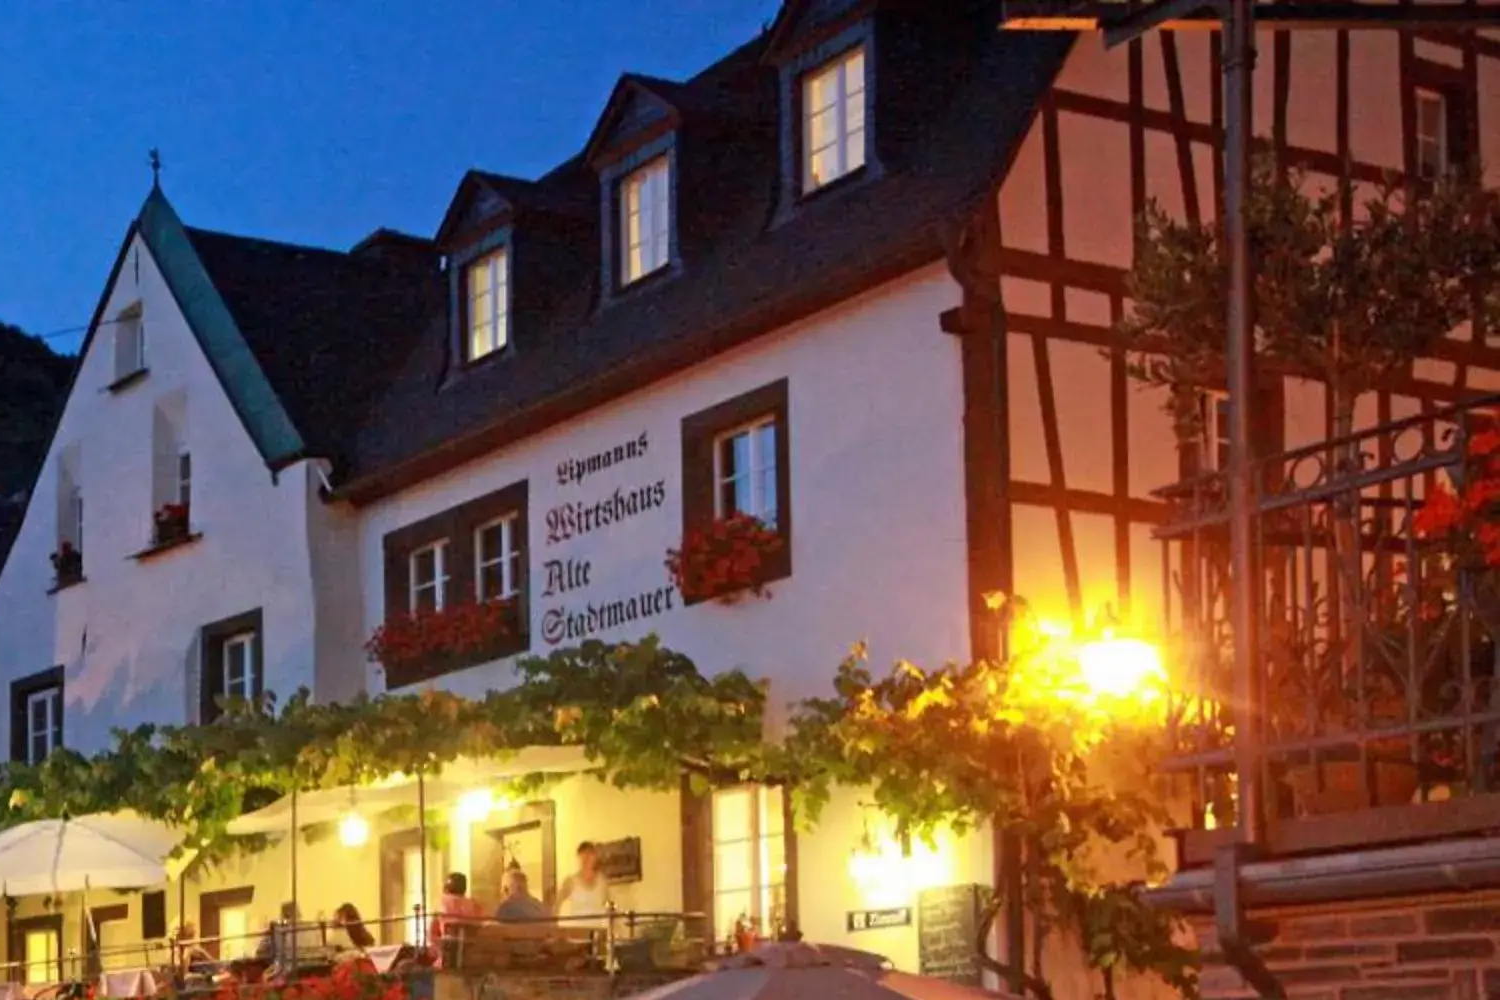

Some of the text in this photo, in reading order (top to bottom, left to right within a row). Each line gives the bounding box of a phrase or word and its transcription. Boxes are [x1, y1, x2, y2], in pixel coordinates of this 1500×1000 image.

[556, 432, 649, 485] Lipmanns
[546, 480, 666, 544] Wirtshaus
[541, 557, 592, 597] Alte
[541, 583, 675, 644] Stadtmauer
